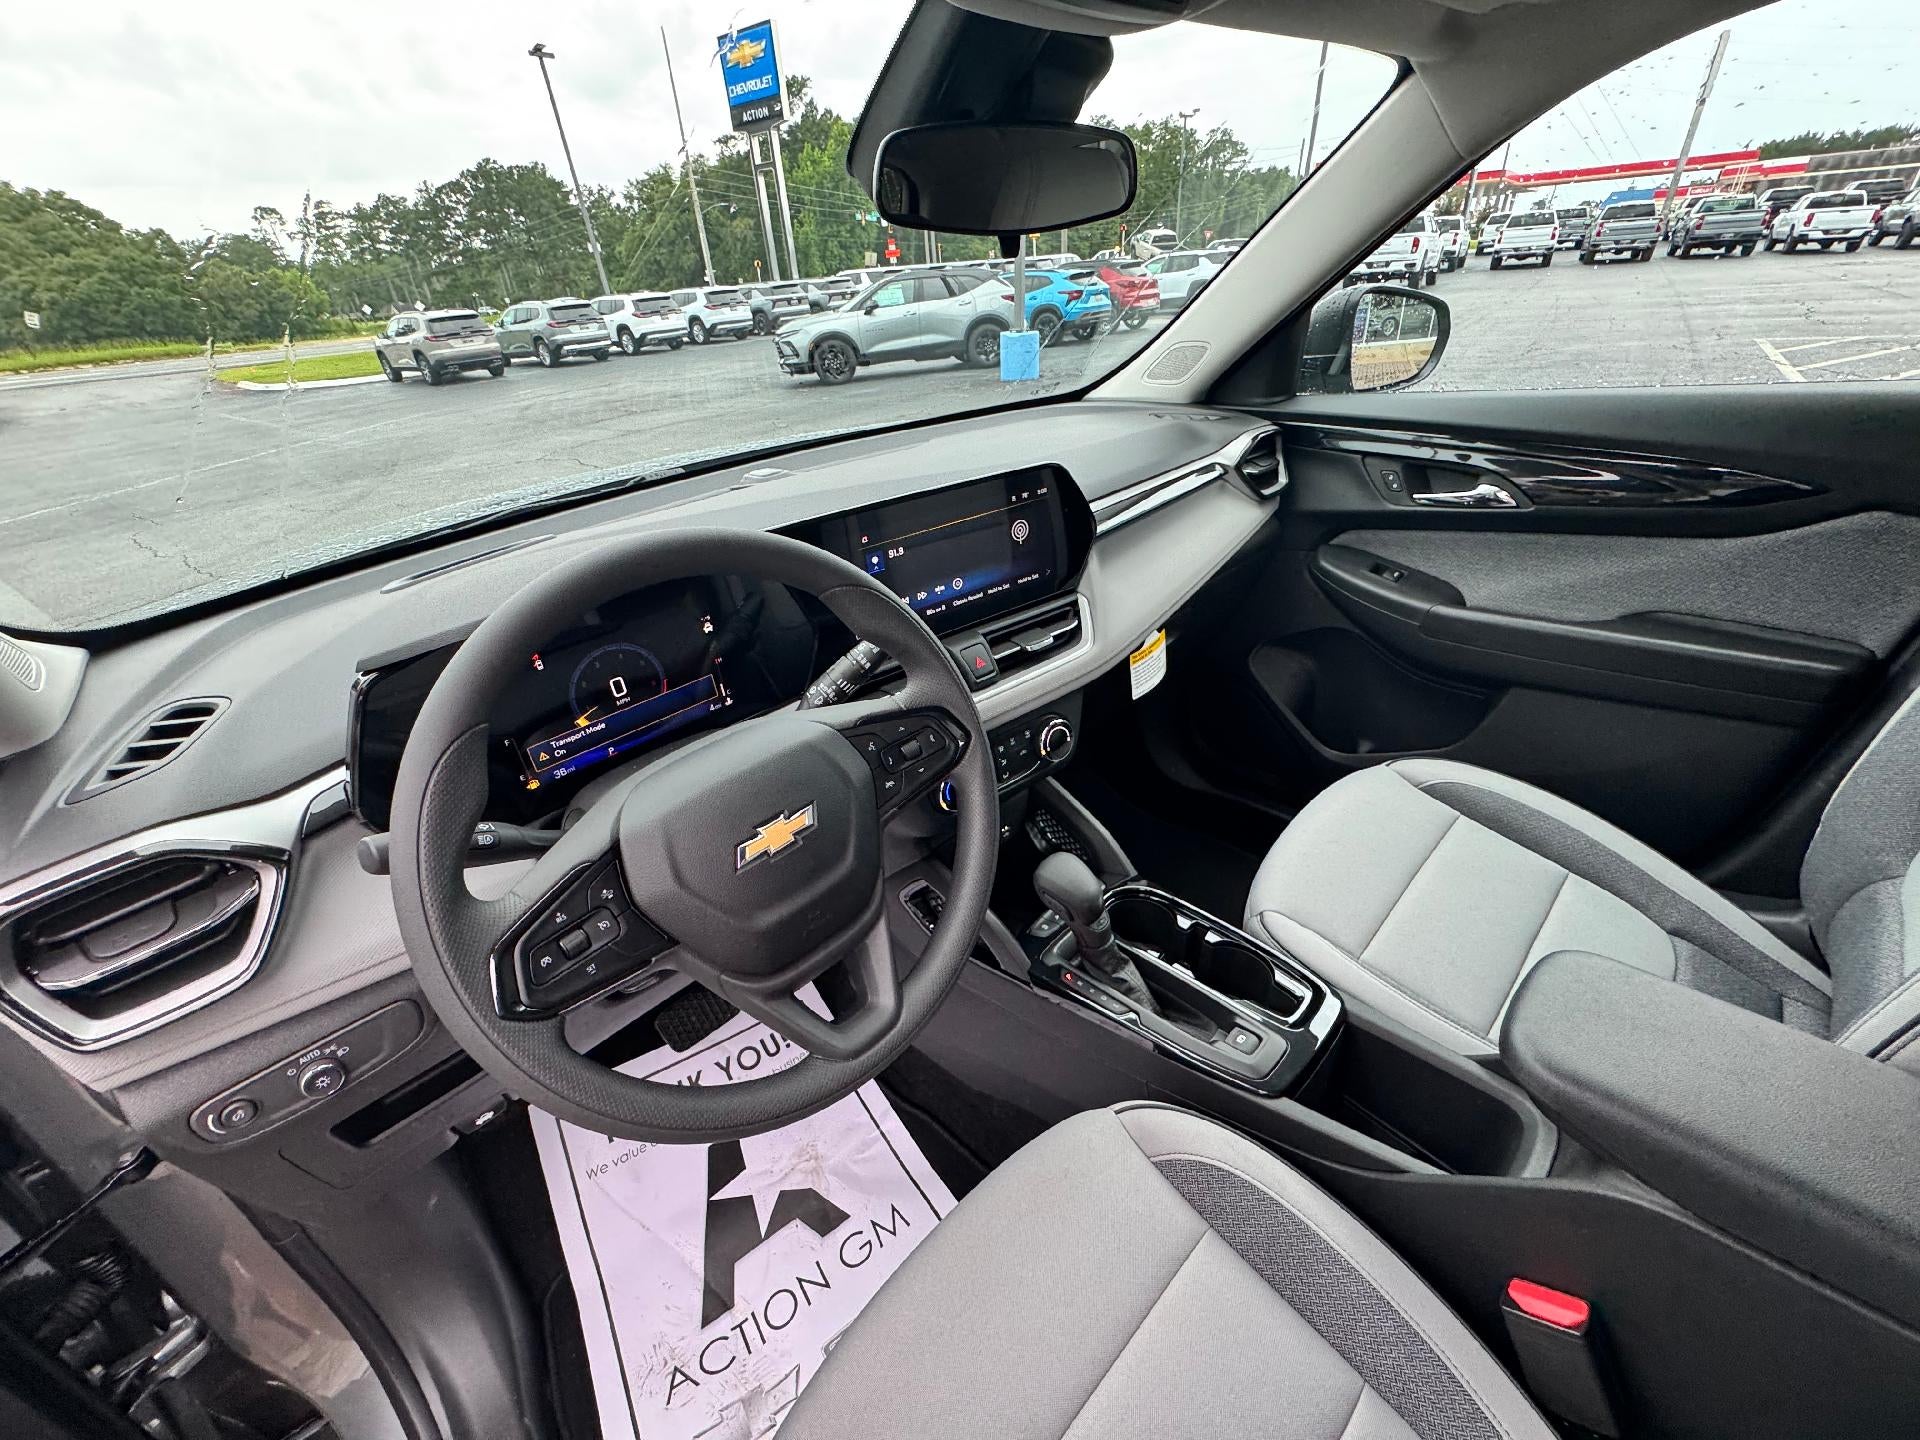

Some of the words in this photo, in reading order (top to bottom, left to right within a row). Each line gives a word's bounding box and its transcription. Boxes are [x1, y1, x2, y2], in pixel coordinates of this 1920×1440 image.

[728, 75, 773, 97] CHEVROLET
[742, 106, 769, 122] ACTION
[609, 676, 627, 698] 0
[616, 697, 631, 707] MPH
[550, 730, 586, 749] Transport
[586, 722, 606, 735] Mode
[554, 748, 567, 758] On
[299, 1050, 321, 1065] AUTO
[714, 1032, 791, 1082] YOU!
[586, 1163, 609, 1180] We
[612, 1143, 647, 1167] value
[666, 1260, 832, 1406] ACTION
[839, 1203, 911, 1269] GM
